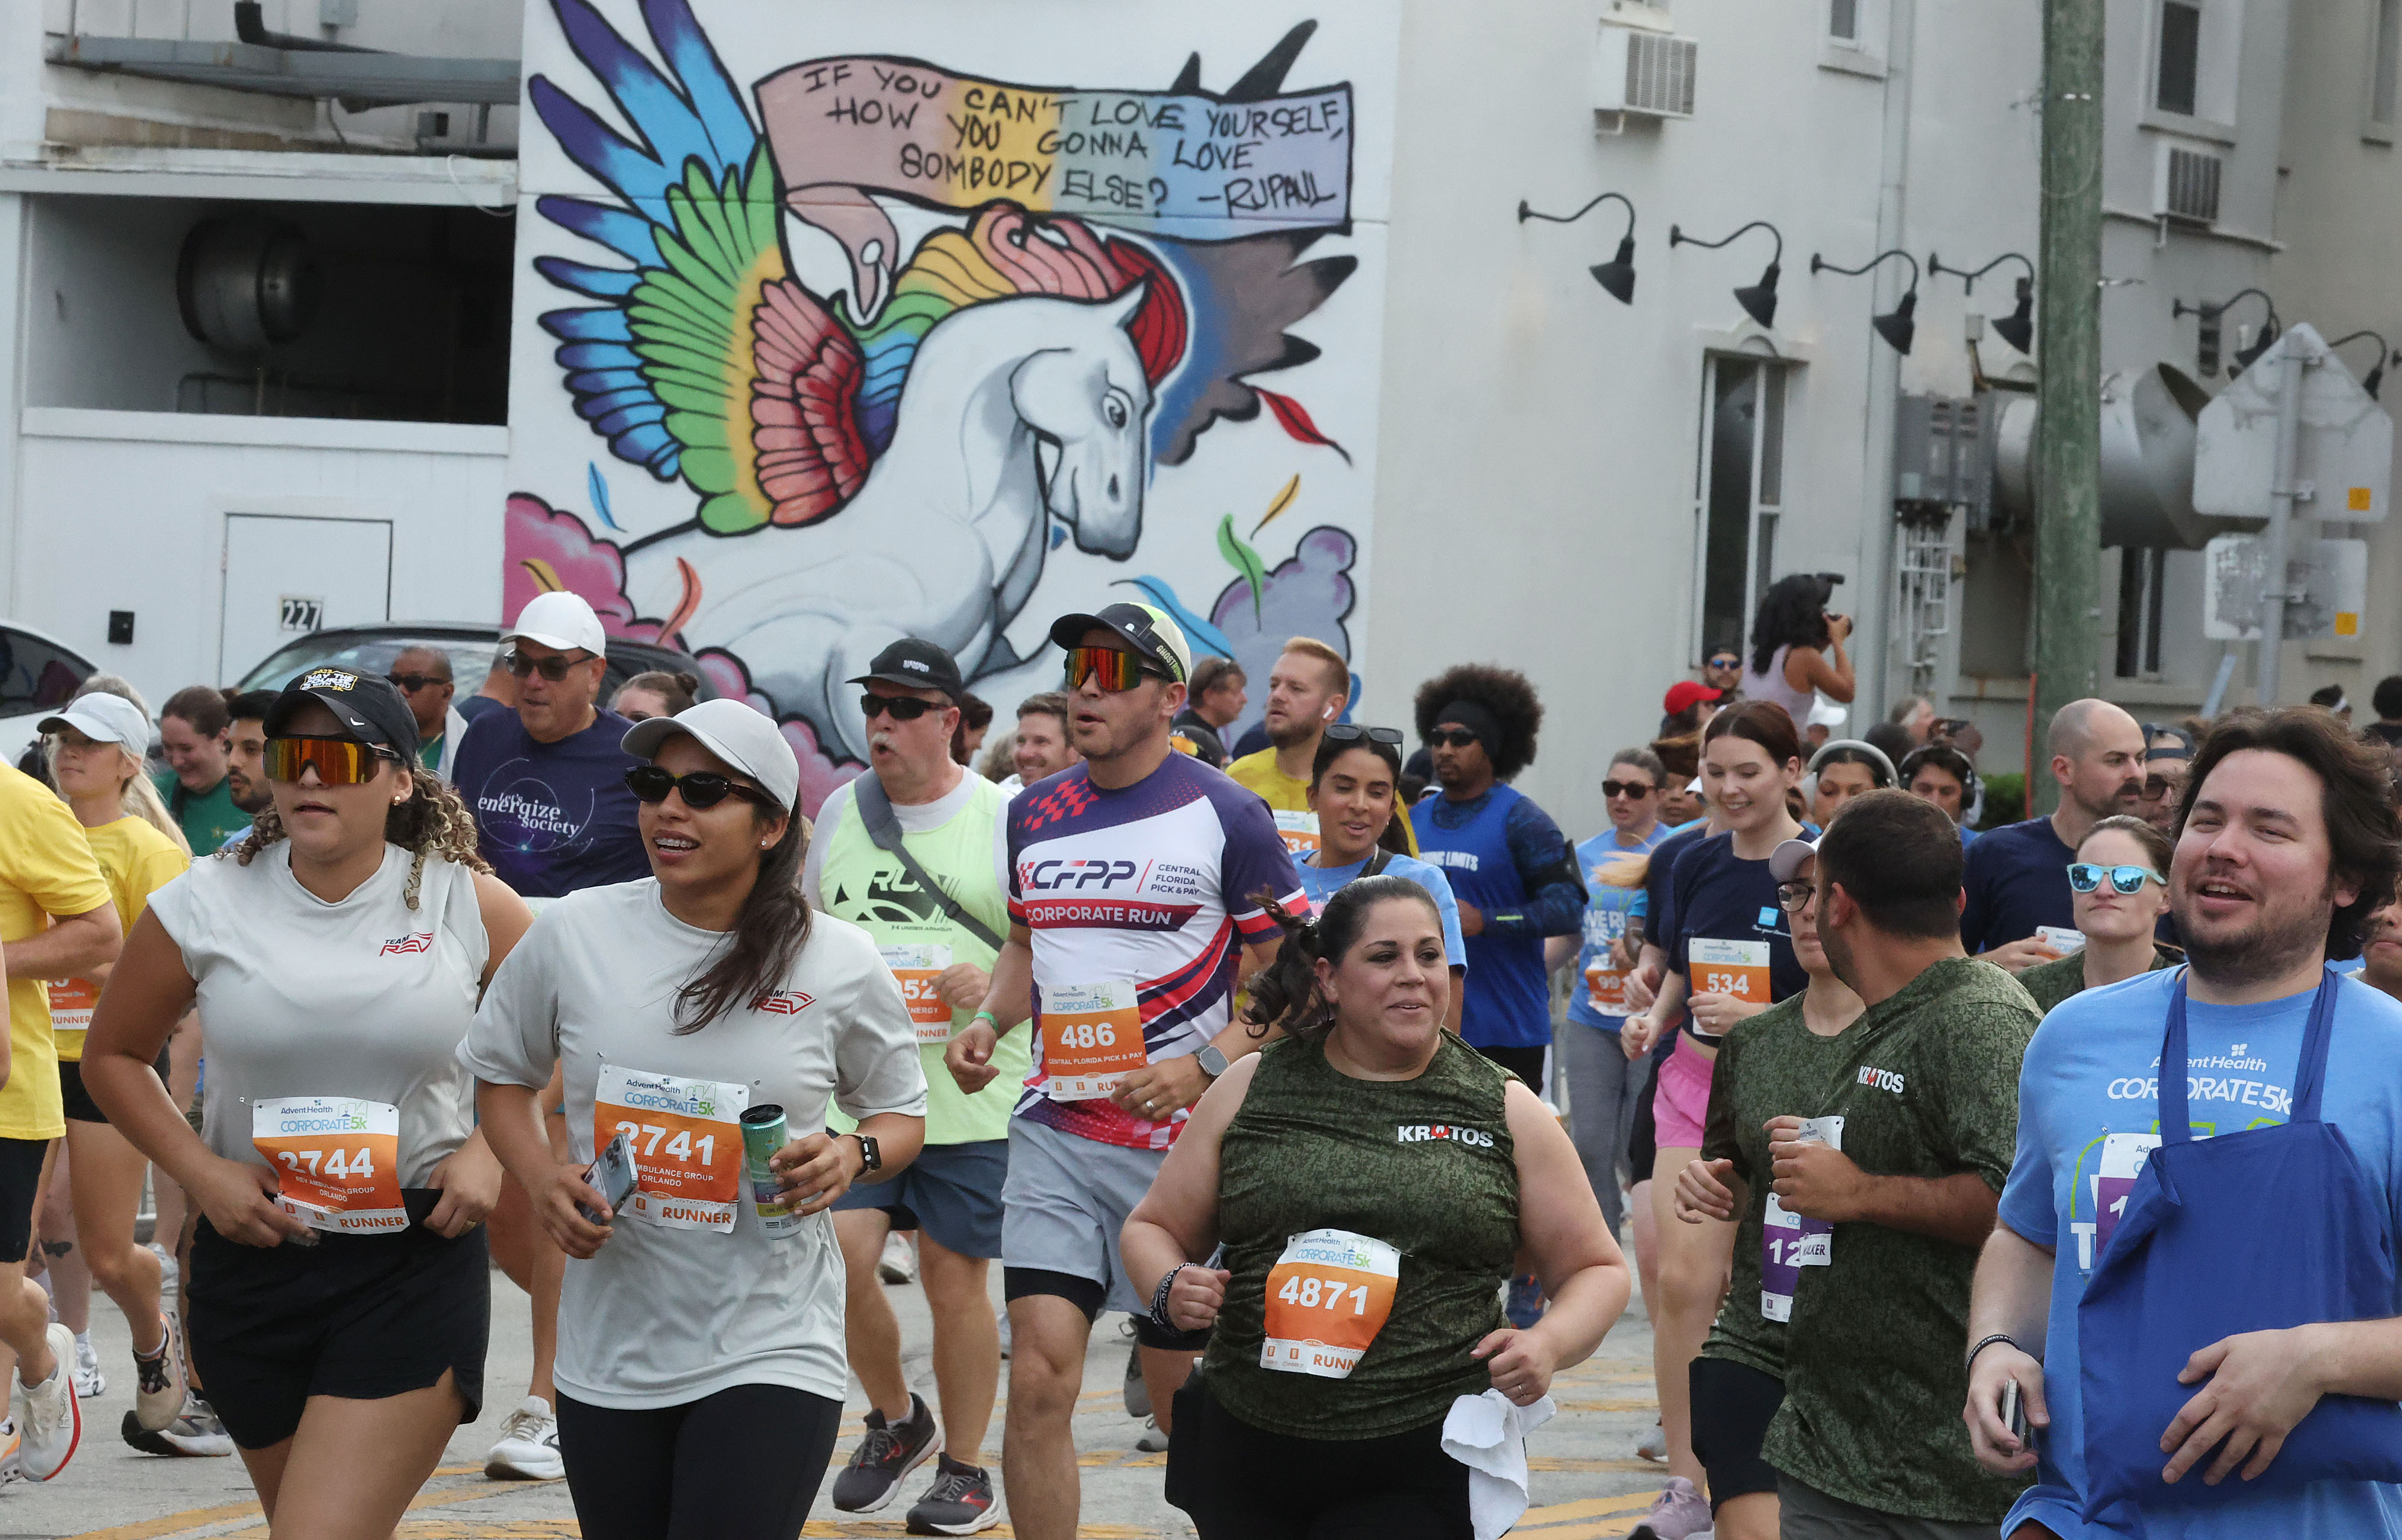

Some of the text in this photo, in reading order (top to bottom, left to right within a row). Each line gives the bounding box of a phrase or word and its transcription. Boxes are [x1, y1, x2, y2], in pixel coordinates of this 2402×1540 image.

[802, 63, 1345, 142] IF YOU CAN'T LOVE YOURSELF,
[824, 96, 1263, 171] HOW YOU GONNA LOVE
[1061, 169, 1168, 218] ELSE?
[281, 600, 322, 632] 227
[478, 797, 561, 820] energize
[521, 817, 580, 838] society
[1282, 837, 1313, 855] 31
[874, 868, 926, 893] RU
[1032, 860, 1136, 890] CFPP
[1156, 874, 1196, 885] FLORIDA
[1158, 864, 1201, 876] CENTRAL
[1150, 884, 1175, 893] PICK
[1026, 906, 1172, 925] CORPORATE RUN
[379, 932, 434, 957] REV
[385, 934, 411, 944] TEAM
[1707, 973, 1750, 995] 534
[1061, 1022, 1116, 1049] 486
[1074, 1055, 1103, 1064] FLORIDA
[1104, 1054, 1120, 1063] PICK
[626, 1078, 681, 1095] AdventHealth
[1856, 1065, 1905, 1093] KRATOS
[2107, 1077, 2293, 1115] CORORATE5k
[280, 1106, 333, 1115] AdventHealth
[615, 1120, 715, 1166] 2741
[1398, 1124, 1494, 1148] KRATOS
[277, 1148, 374, 1180] 2744
[637, 1164, 714, 1181] MBULANCE GROUP
[309, 1179, 346, 1193] AMBULANCE
[641, 1174, 682, 1187] ORLANDO
[319, 1189, 348, 1202] ORLANDO
[339, 1216, 405, 1228] RUNNER
[663, 1207, 731, 1224] RUNNER
[1278, 1275, 1369, 1316] 4871
[1313, 1354, 1358, 1371] RUNN
